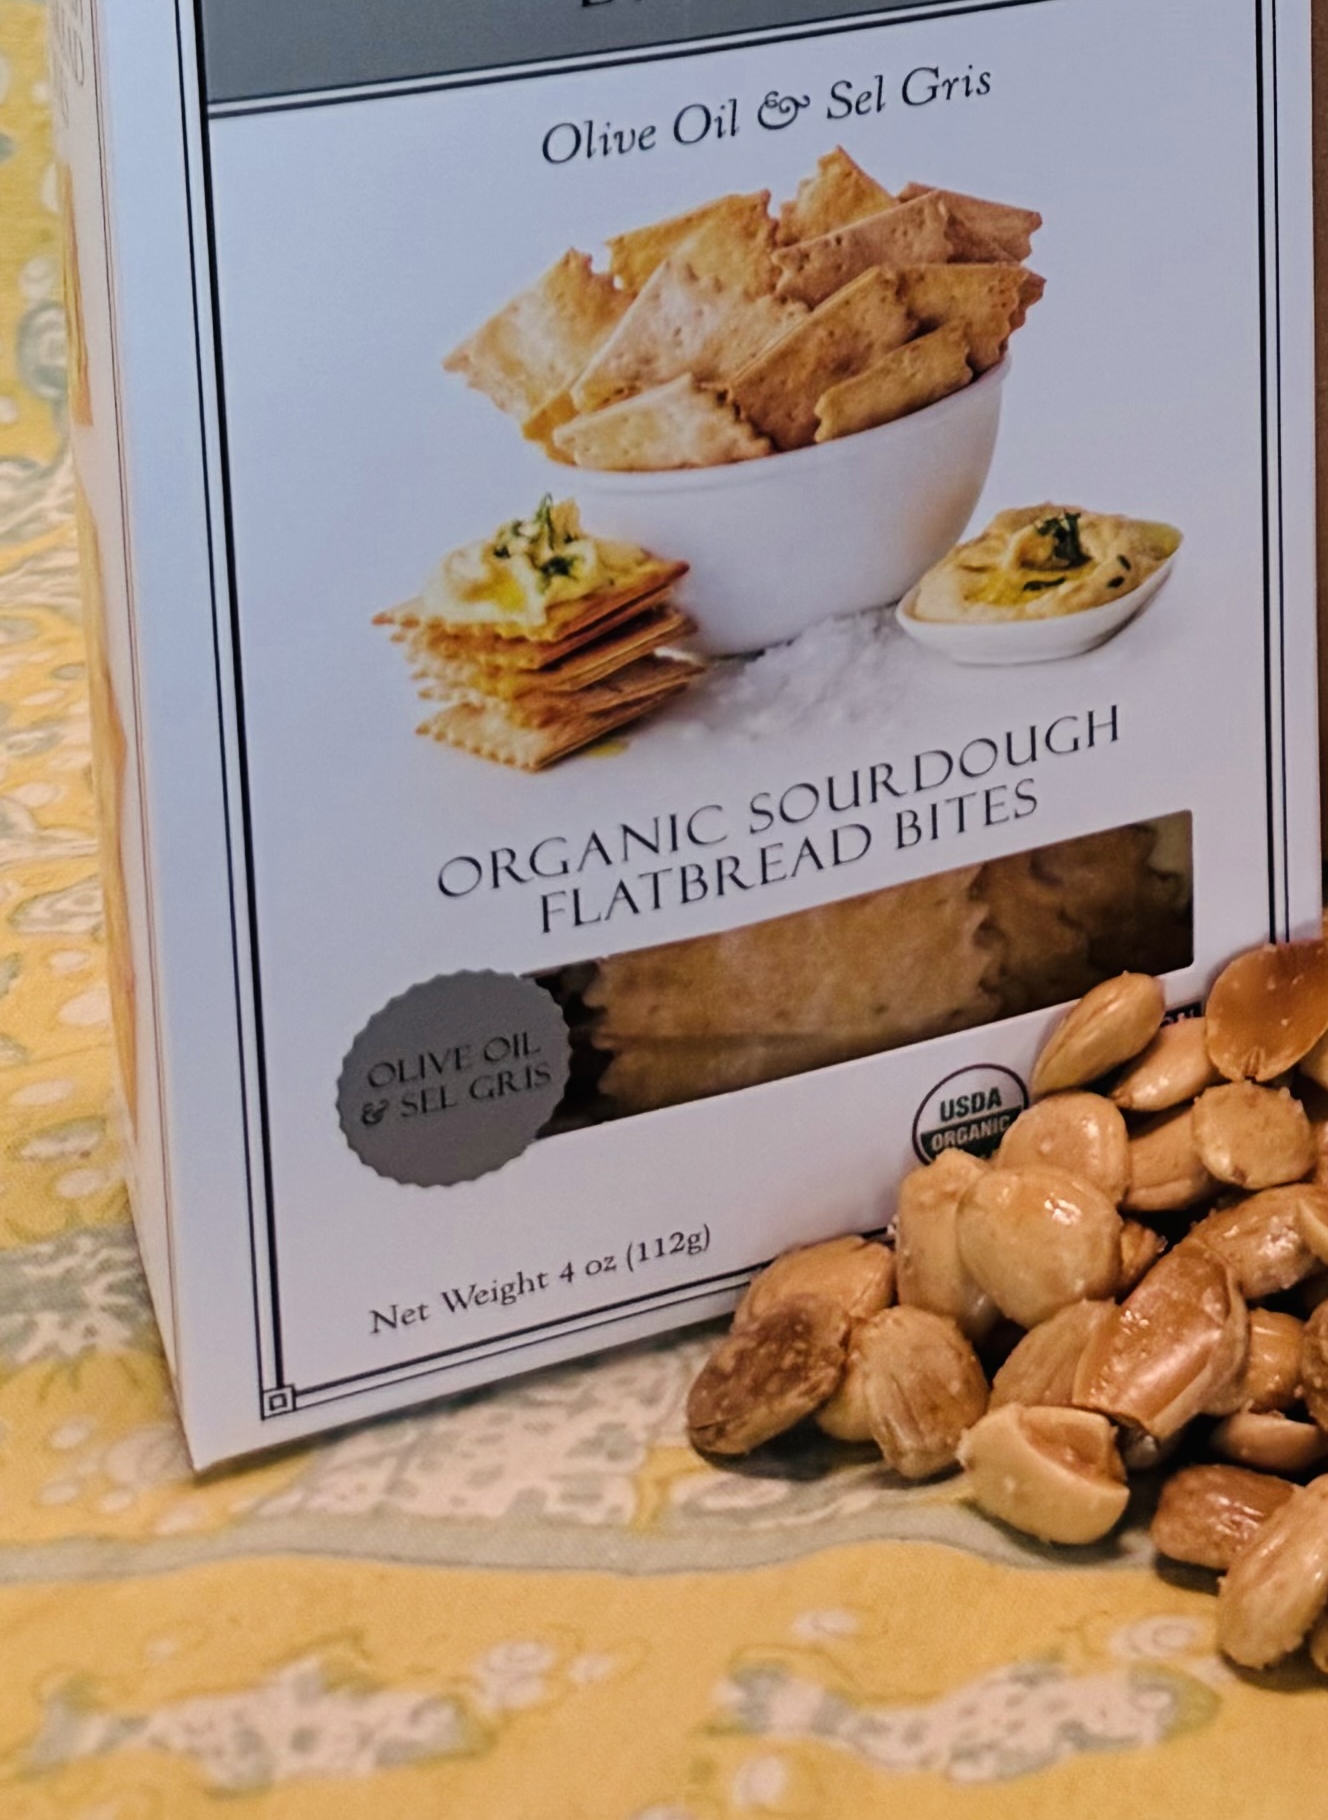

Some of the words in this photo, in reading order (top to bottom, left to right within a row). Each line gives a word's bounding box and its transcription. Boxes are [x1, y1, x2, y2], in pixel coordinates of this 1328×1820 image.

[542, 122, 657, 164] Olive
[673, 99, 738, 146] Oil
[757, 90, 812, 130] &
[826, 75, 885, 121] Sel
[901, 64, 992, 107] Gris
[437, 804, 728, 899] ORGANIC
[748, 704, 1121, 835] SOURDOUGH
[539, 822, 872, 934] FLATBREAD
[896, 777, 1038, 851] BITES
[360, 1097, 392, 1127] &
[400, 1082, 457, 1121] SEL
[469, 1060, 552, 1102] GRIS
[366, 1043, 471, 1092] OLIVE
[482, 1031, 542, 1063] OIL
[931, 1115, 1010, 1152] ORGANIC
[940, 1087, 1002, 1122] USDA
[370, 1302, 429, 1334] Net
[440, 1268, 550, 1314] Weight
[559, 1259, 574, 1286] 4
[584, 1252, 619, 1277] oz
[625, 1222, 713, 1271] (112g)
